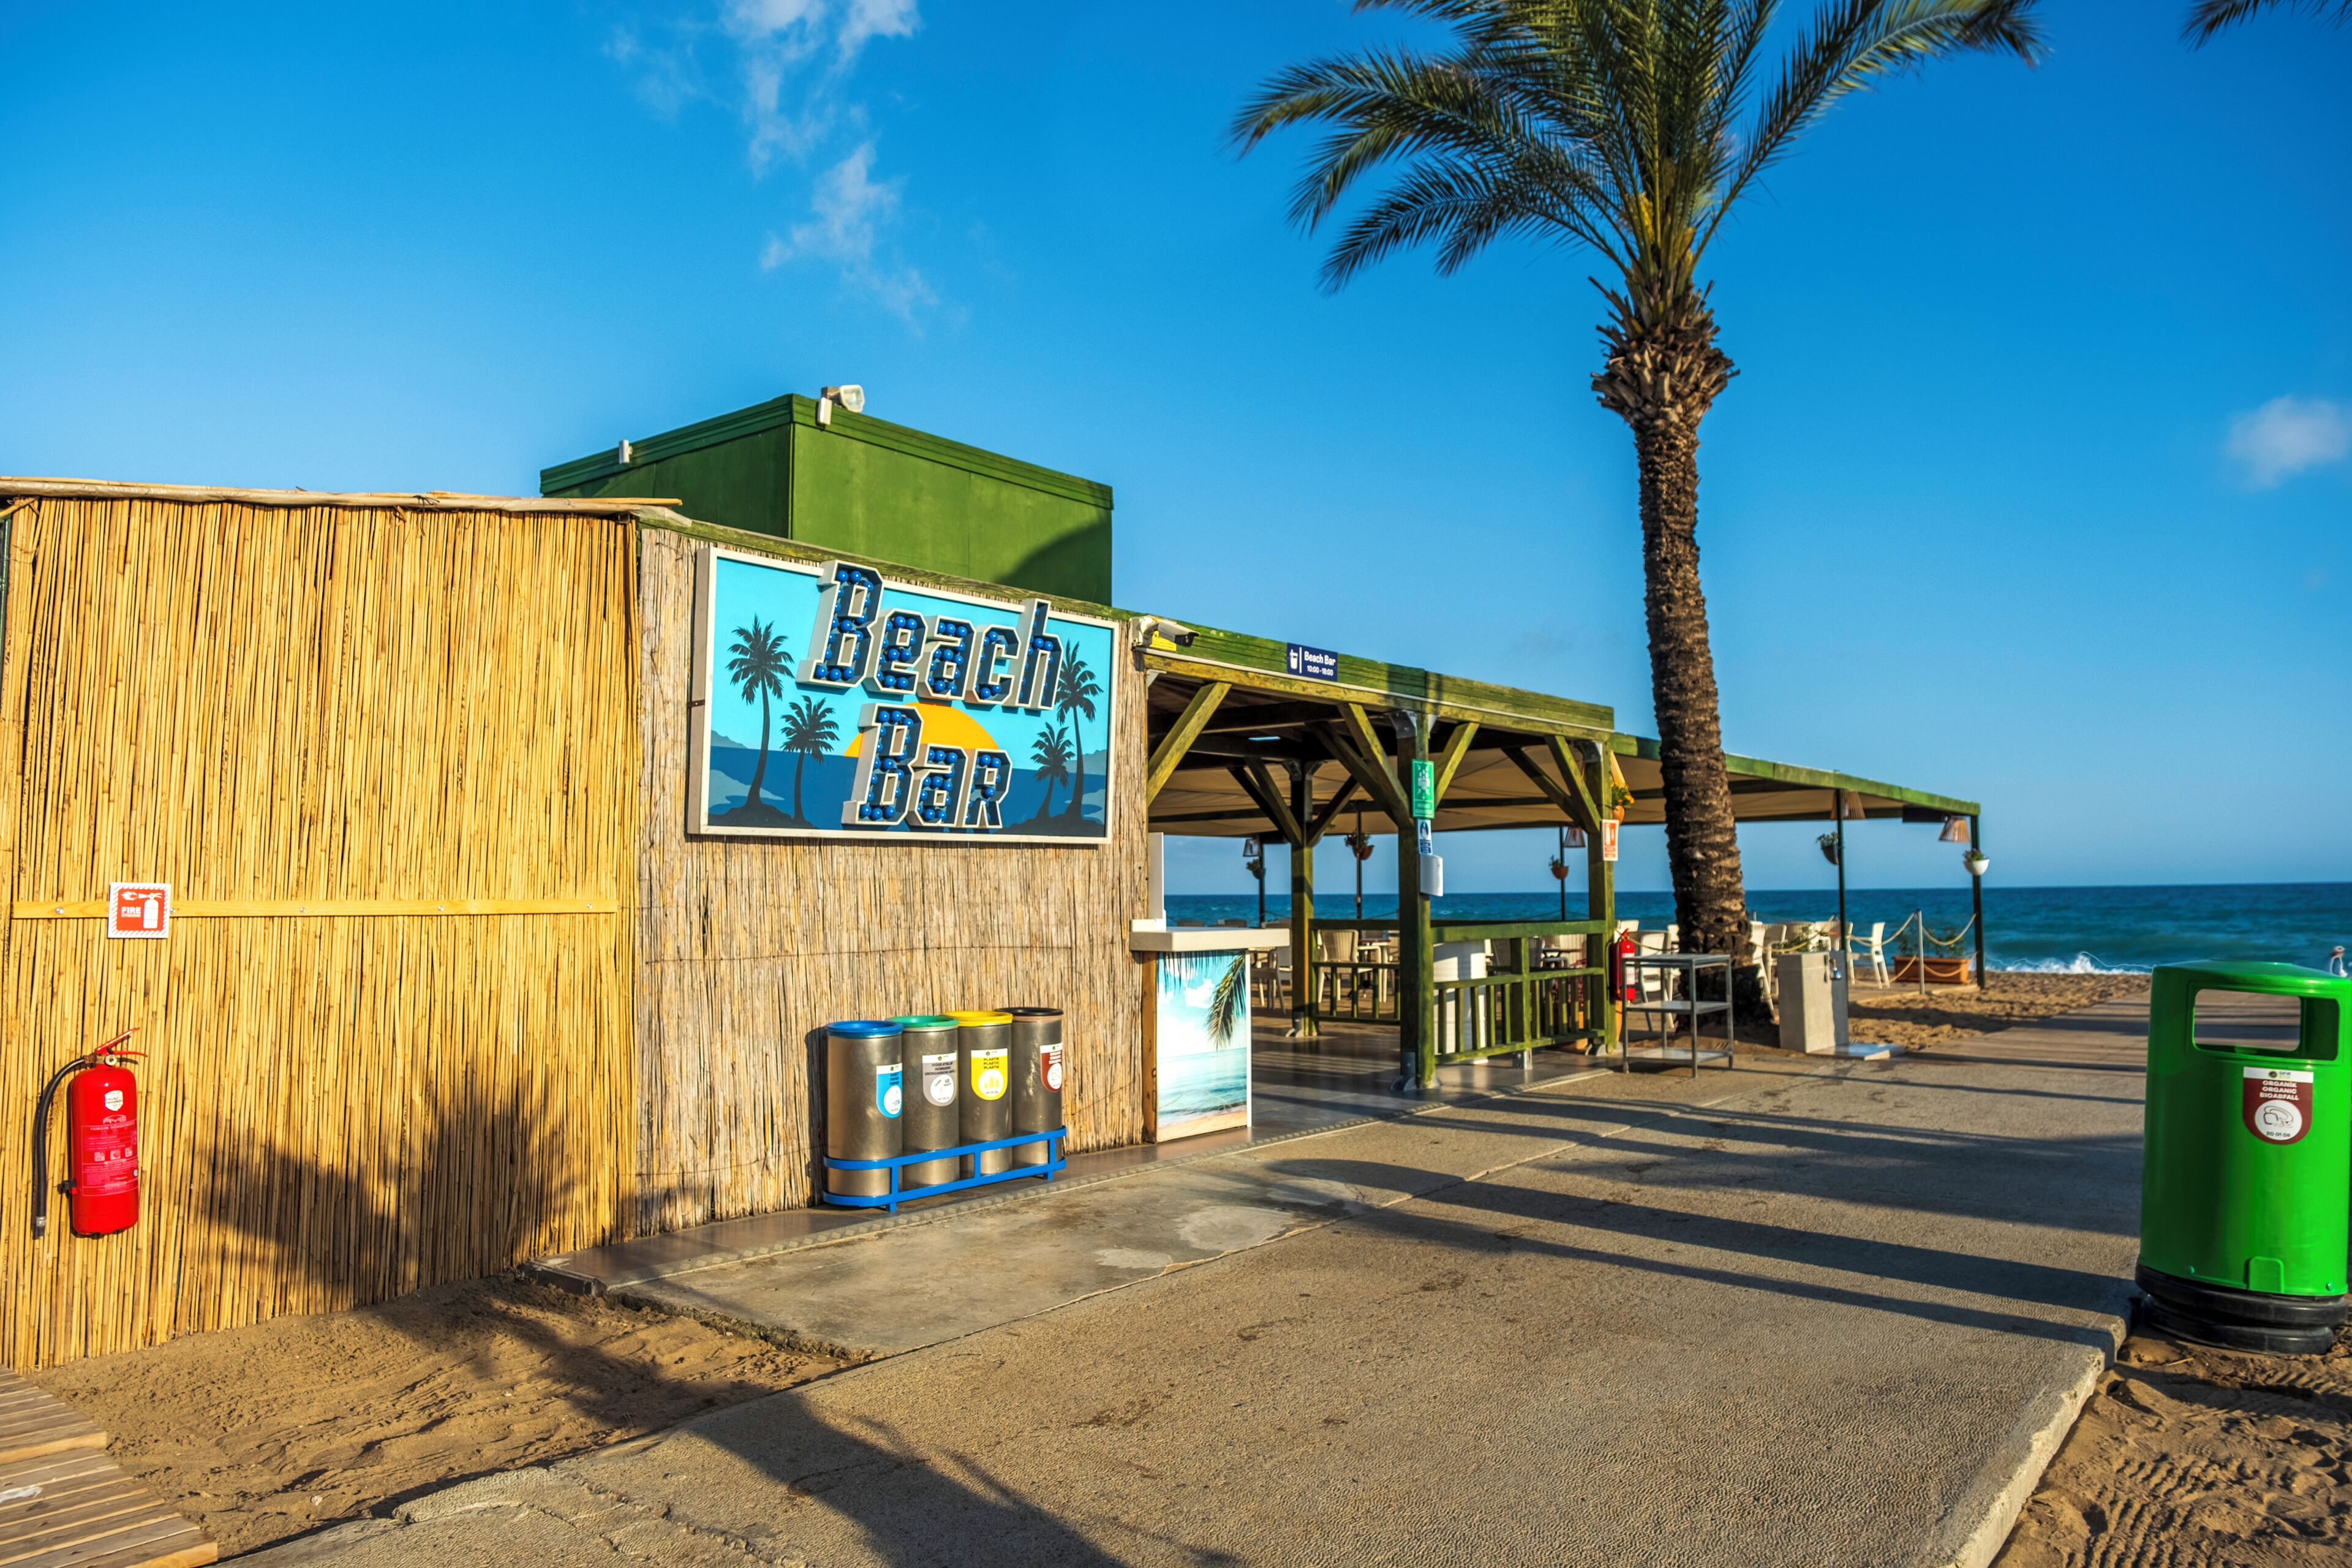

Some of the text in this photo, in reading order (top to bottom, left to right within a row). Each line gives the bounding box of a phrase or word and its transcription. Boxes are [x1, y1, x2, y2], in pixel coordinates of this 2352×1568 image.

[796, 559, 1064, 710] Beach
[1304, 651, 1336, 666] Beach Bar
[1306, 665, 1319, 674] 10:00
[842, 703, 1012, 829] Bar
[2260, 1092, 2299, 1101] BIOABFALL
